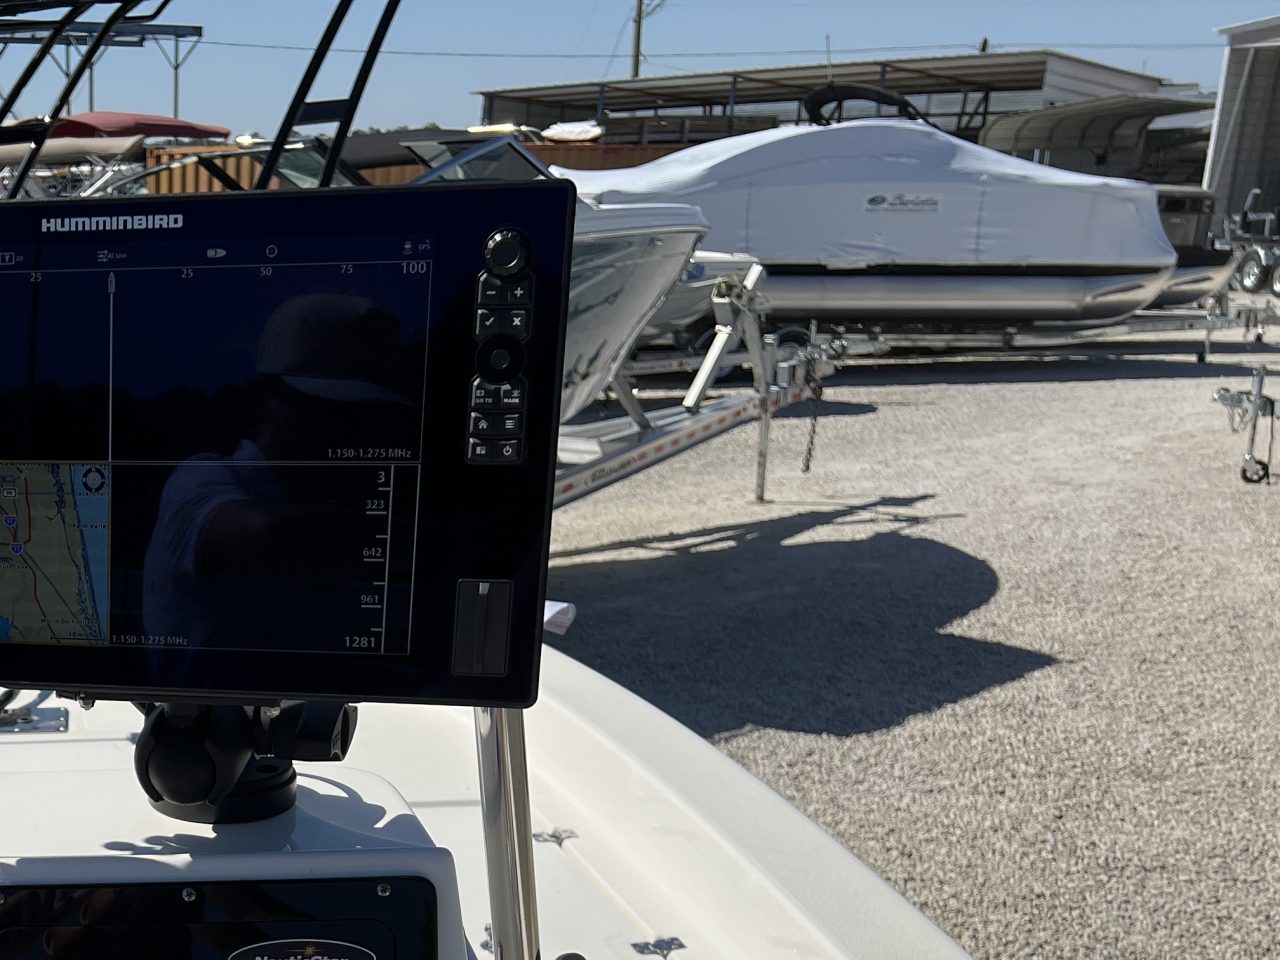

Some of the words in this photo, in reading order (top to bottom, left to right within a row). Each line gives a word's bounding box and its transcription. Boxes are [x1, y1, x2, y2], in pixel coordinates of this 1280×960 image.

[41, 214, 183, 233] HUMMINBIRD
[260, 266, 272, 276] 50
[340, 264, 353, 274] 75
[401, 261, 426, 274] 100
[30, 272, 42, 282] 25
[181, 268, 193, 279] 25
[327, 448, 386, 459] 1.150-1.275
[388, 448, 412, 459] MHz
[376, 471, 385, 483] 3
[365, 500, 384, 510] 323
[362, 547, 382, 557] 642
[360, 594, 379, 604] 961
[111, 635, 165, 645] 1.150-1.275
[166, 636, 188, 646] MHz
[344, 636, 375, 649] 1281
